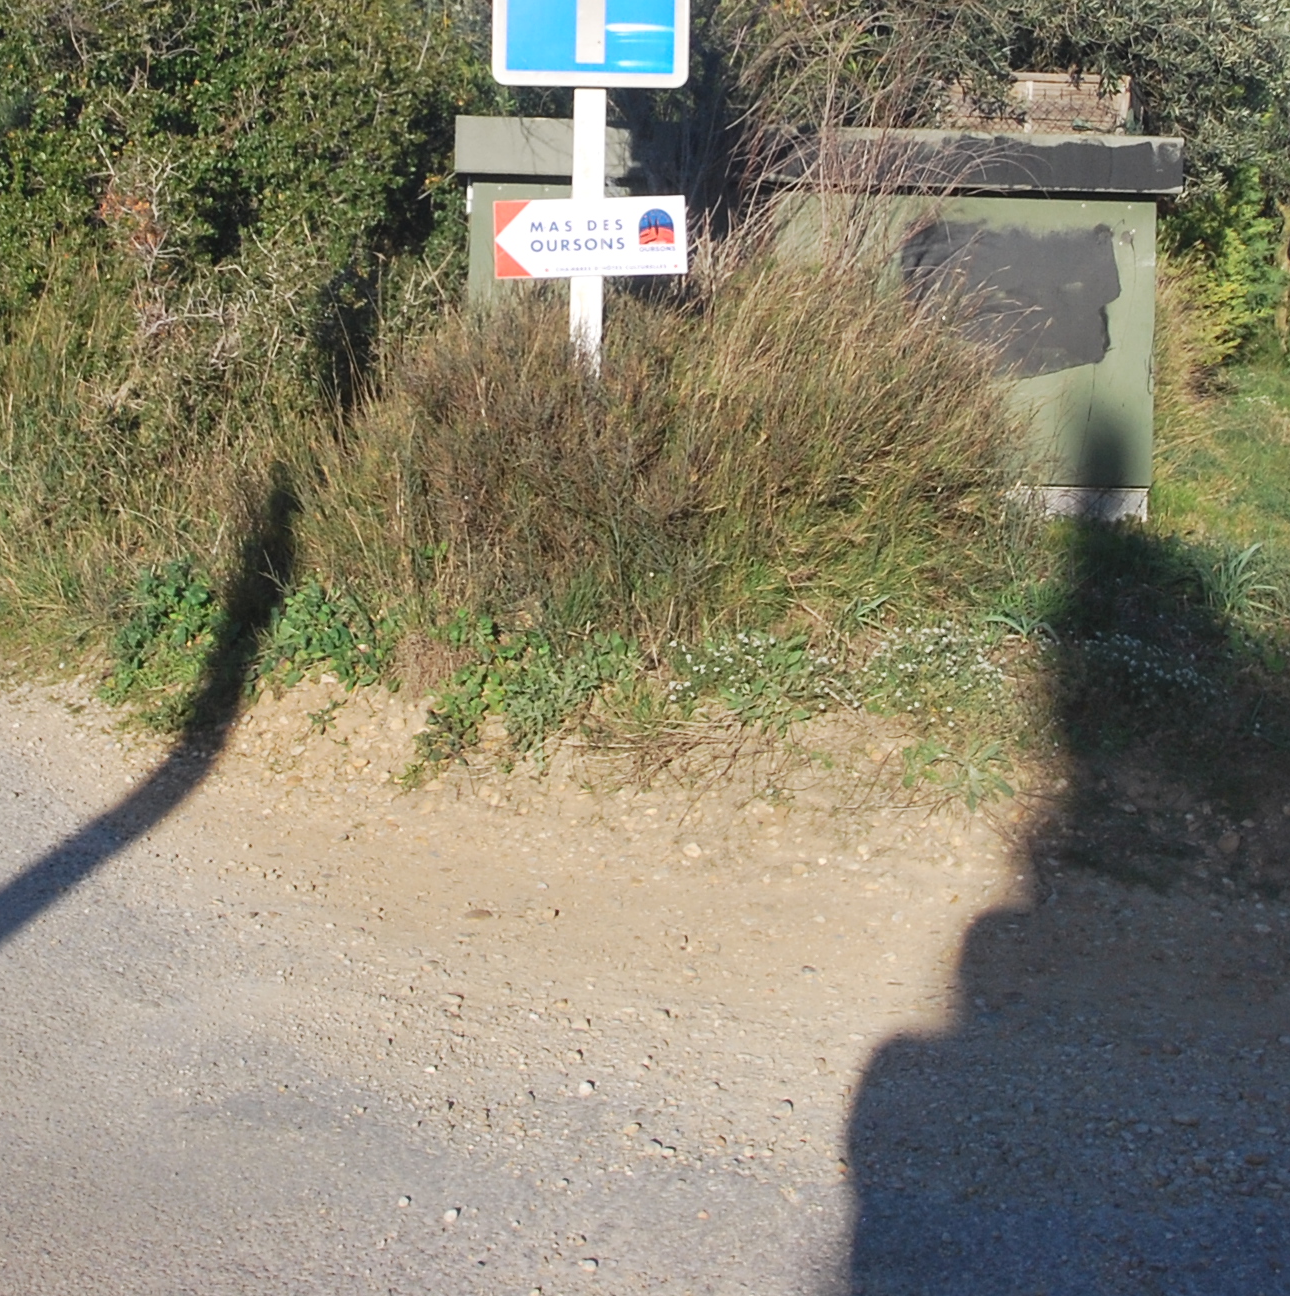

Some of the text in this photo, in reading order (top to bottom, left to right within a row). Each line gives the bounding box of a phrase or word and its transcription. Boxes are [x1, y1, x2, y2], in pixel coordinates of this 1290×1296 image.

[530, 219, 624, 233] MAS DES
[530, 237, 625, 253] OURSONS
